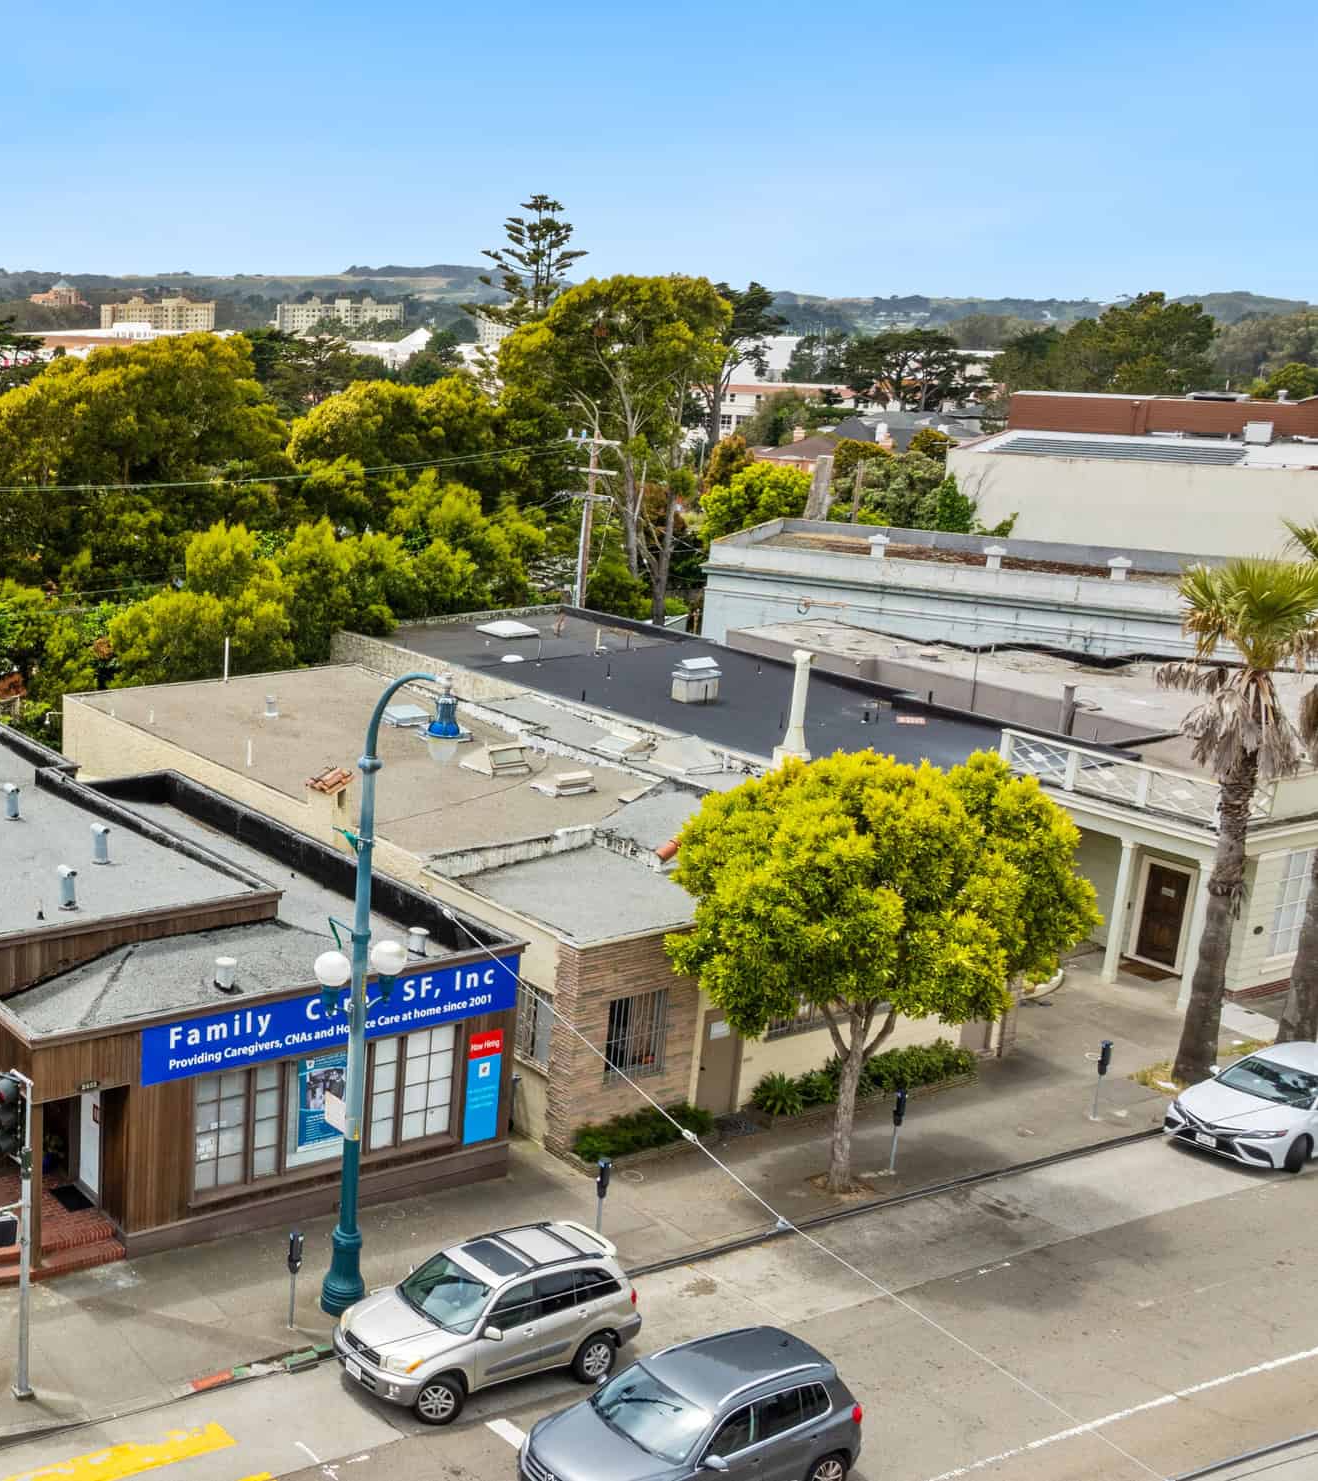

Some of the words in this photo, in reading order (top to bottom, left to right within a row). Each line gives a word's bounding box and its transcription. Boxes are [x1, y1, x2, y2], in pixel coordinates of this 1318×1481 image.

[169, 1011, 271, 1050] Family
[306, 995, 370, 1020] Cr
[403, 976, 441, 1002] SF,
[455, 968, 495, 992] Inc
[169, 1051, 222, 1071] Providing
[224, 1039, 282, 1058] Caregivers,
[285, 1031, 313, 1045] CNAs
[314, 1026, 334, 1040] and
[336, 1019, 376, 1034] Hoce
[377, 1014, 401, 1026] Care
[402, 1010, 412, 1021] at
[414, 1005, 442, 1018] home
[442, 1000, 467, 1012] since
[469, 994, 492, 1008] 2001
